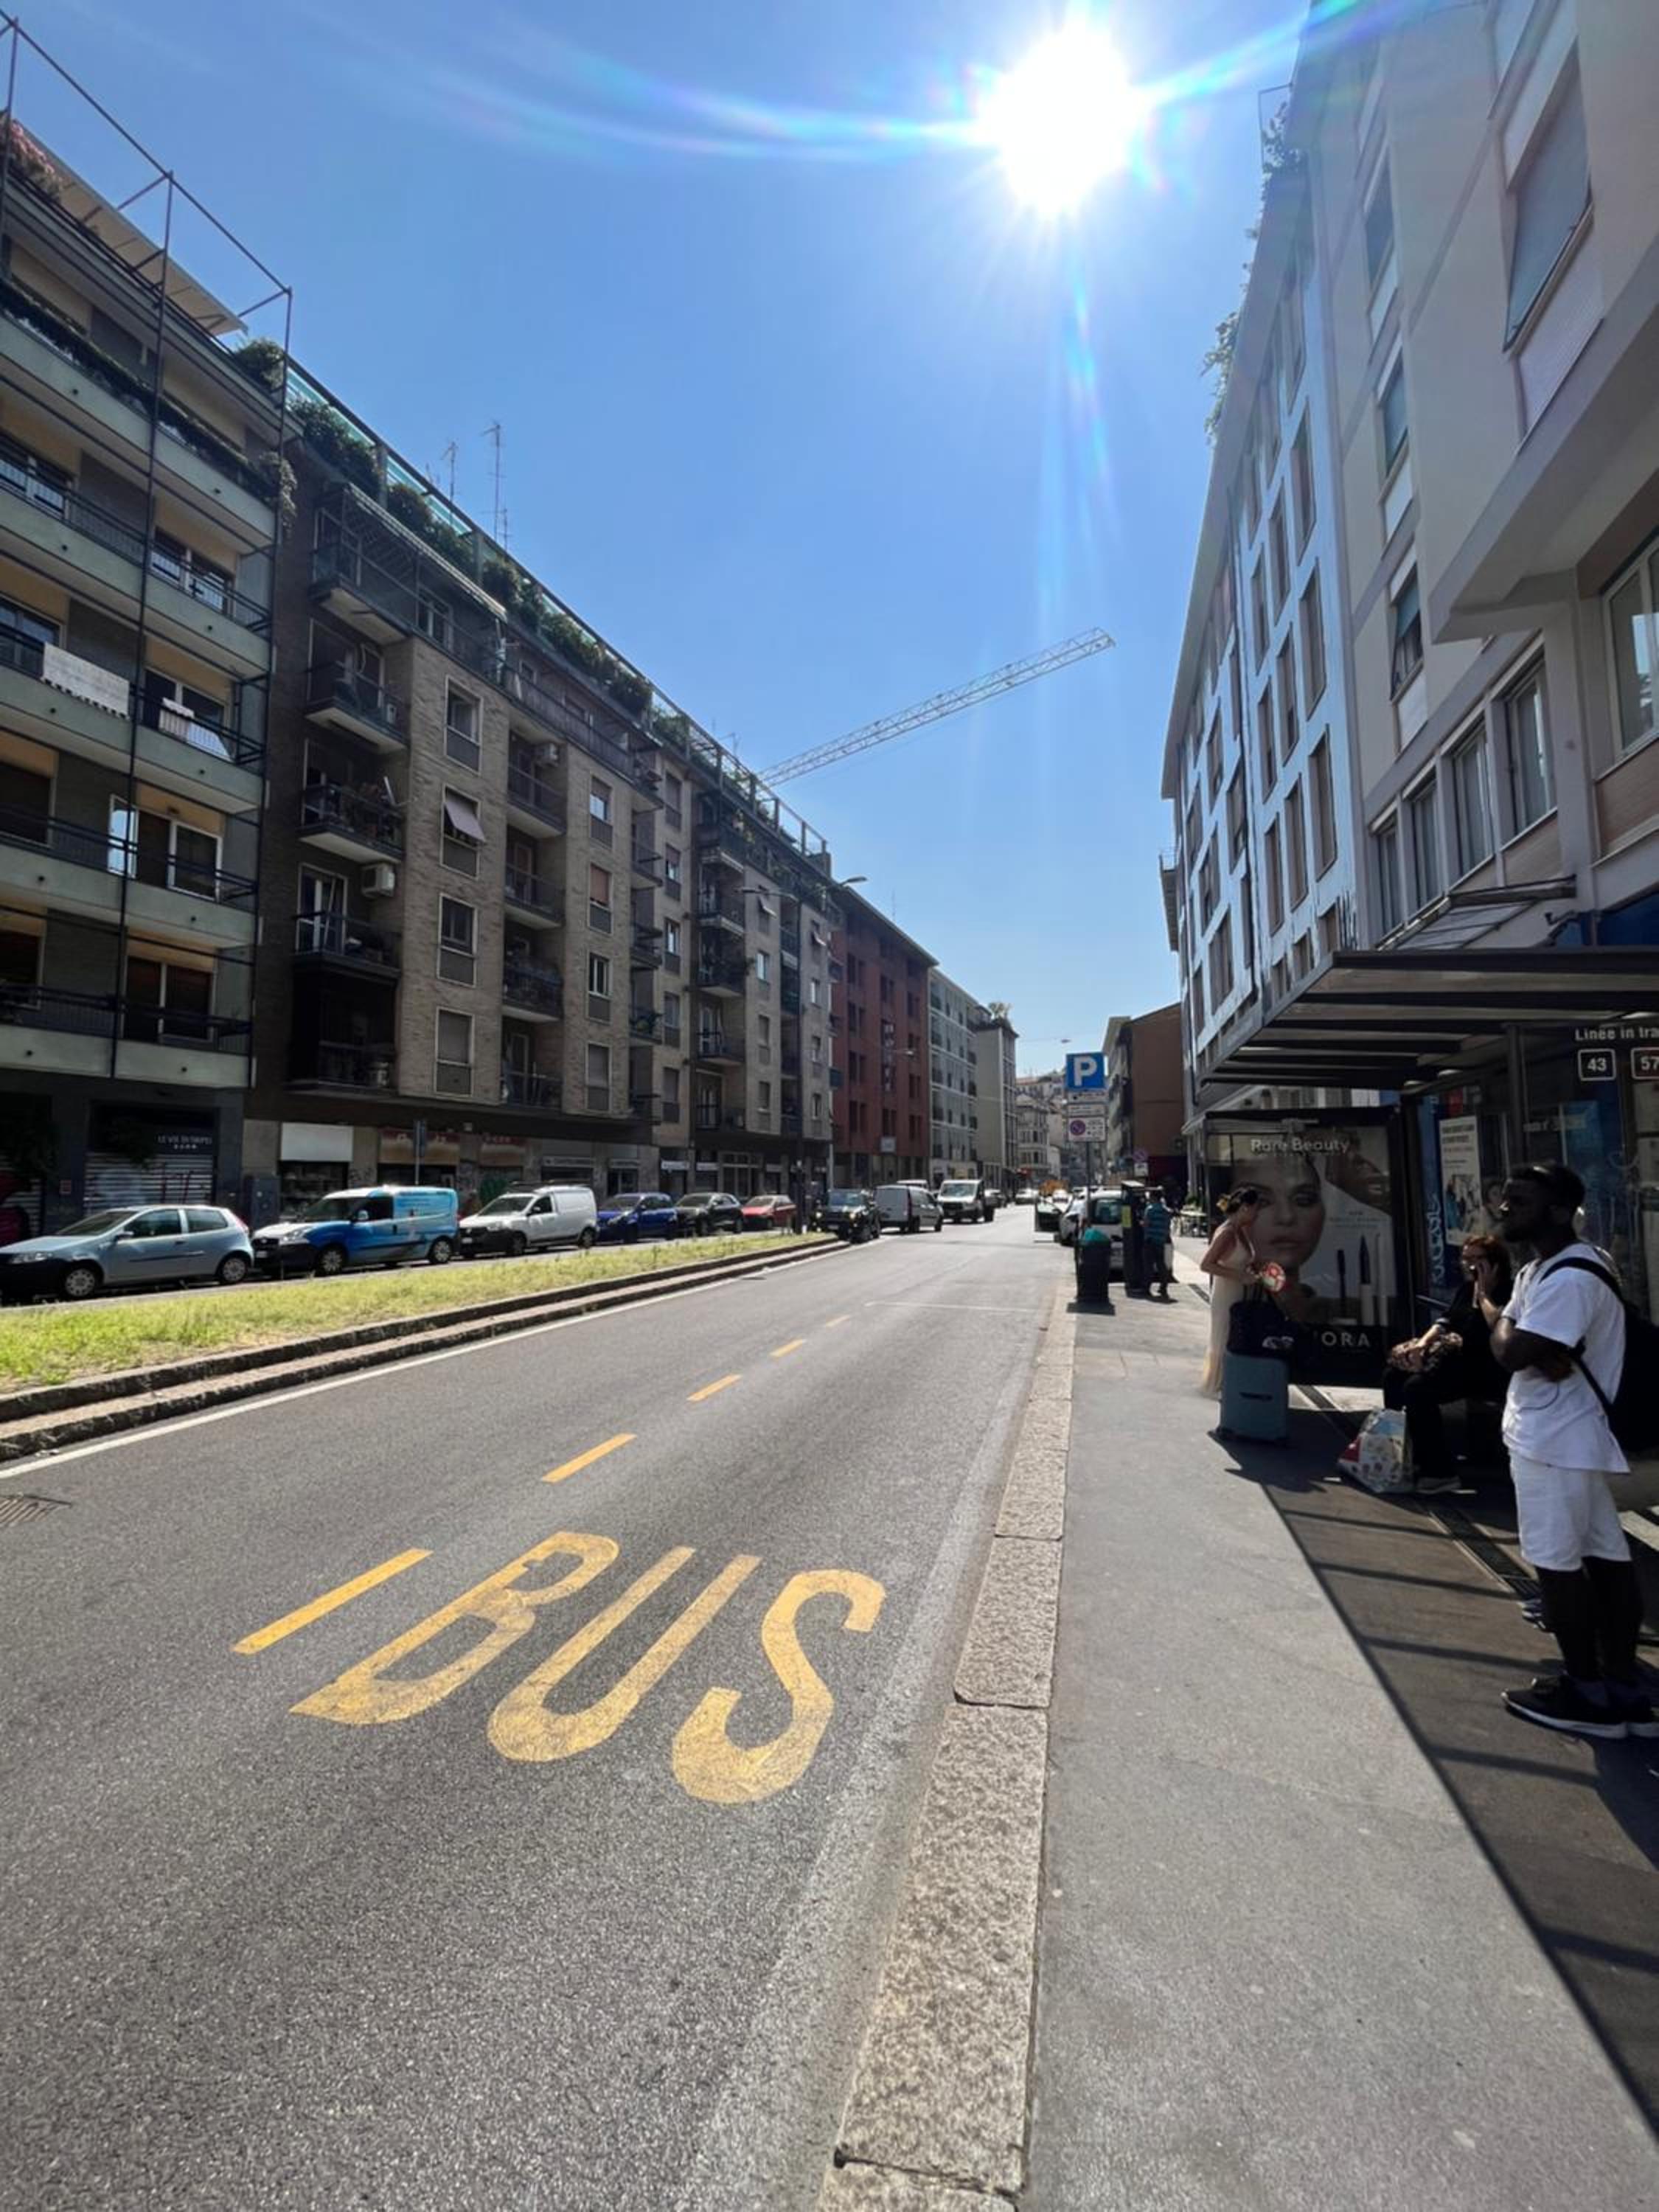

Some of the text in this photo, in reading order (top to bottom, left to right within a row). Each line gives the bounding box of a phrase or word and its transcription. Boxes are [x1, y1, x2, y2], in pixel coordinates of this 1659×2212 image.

[1575, 1028, 1615, 1041] Linee
[1621, 1026, 1635, 1039] in
[1074, 1057, 1097, 1086] P
[1587, 1057, 1606, 1071] 43
[1291, 1137, 1349, 1154] Beauty
[289, 1531, 886, 1804] BUS
